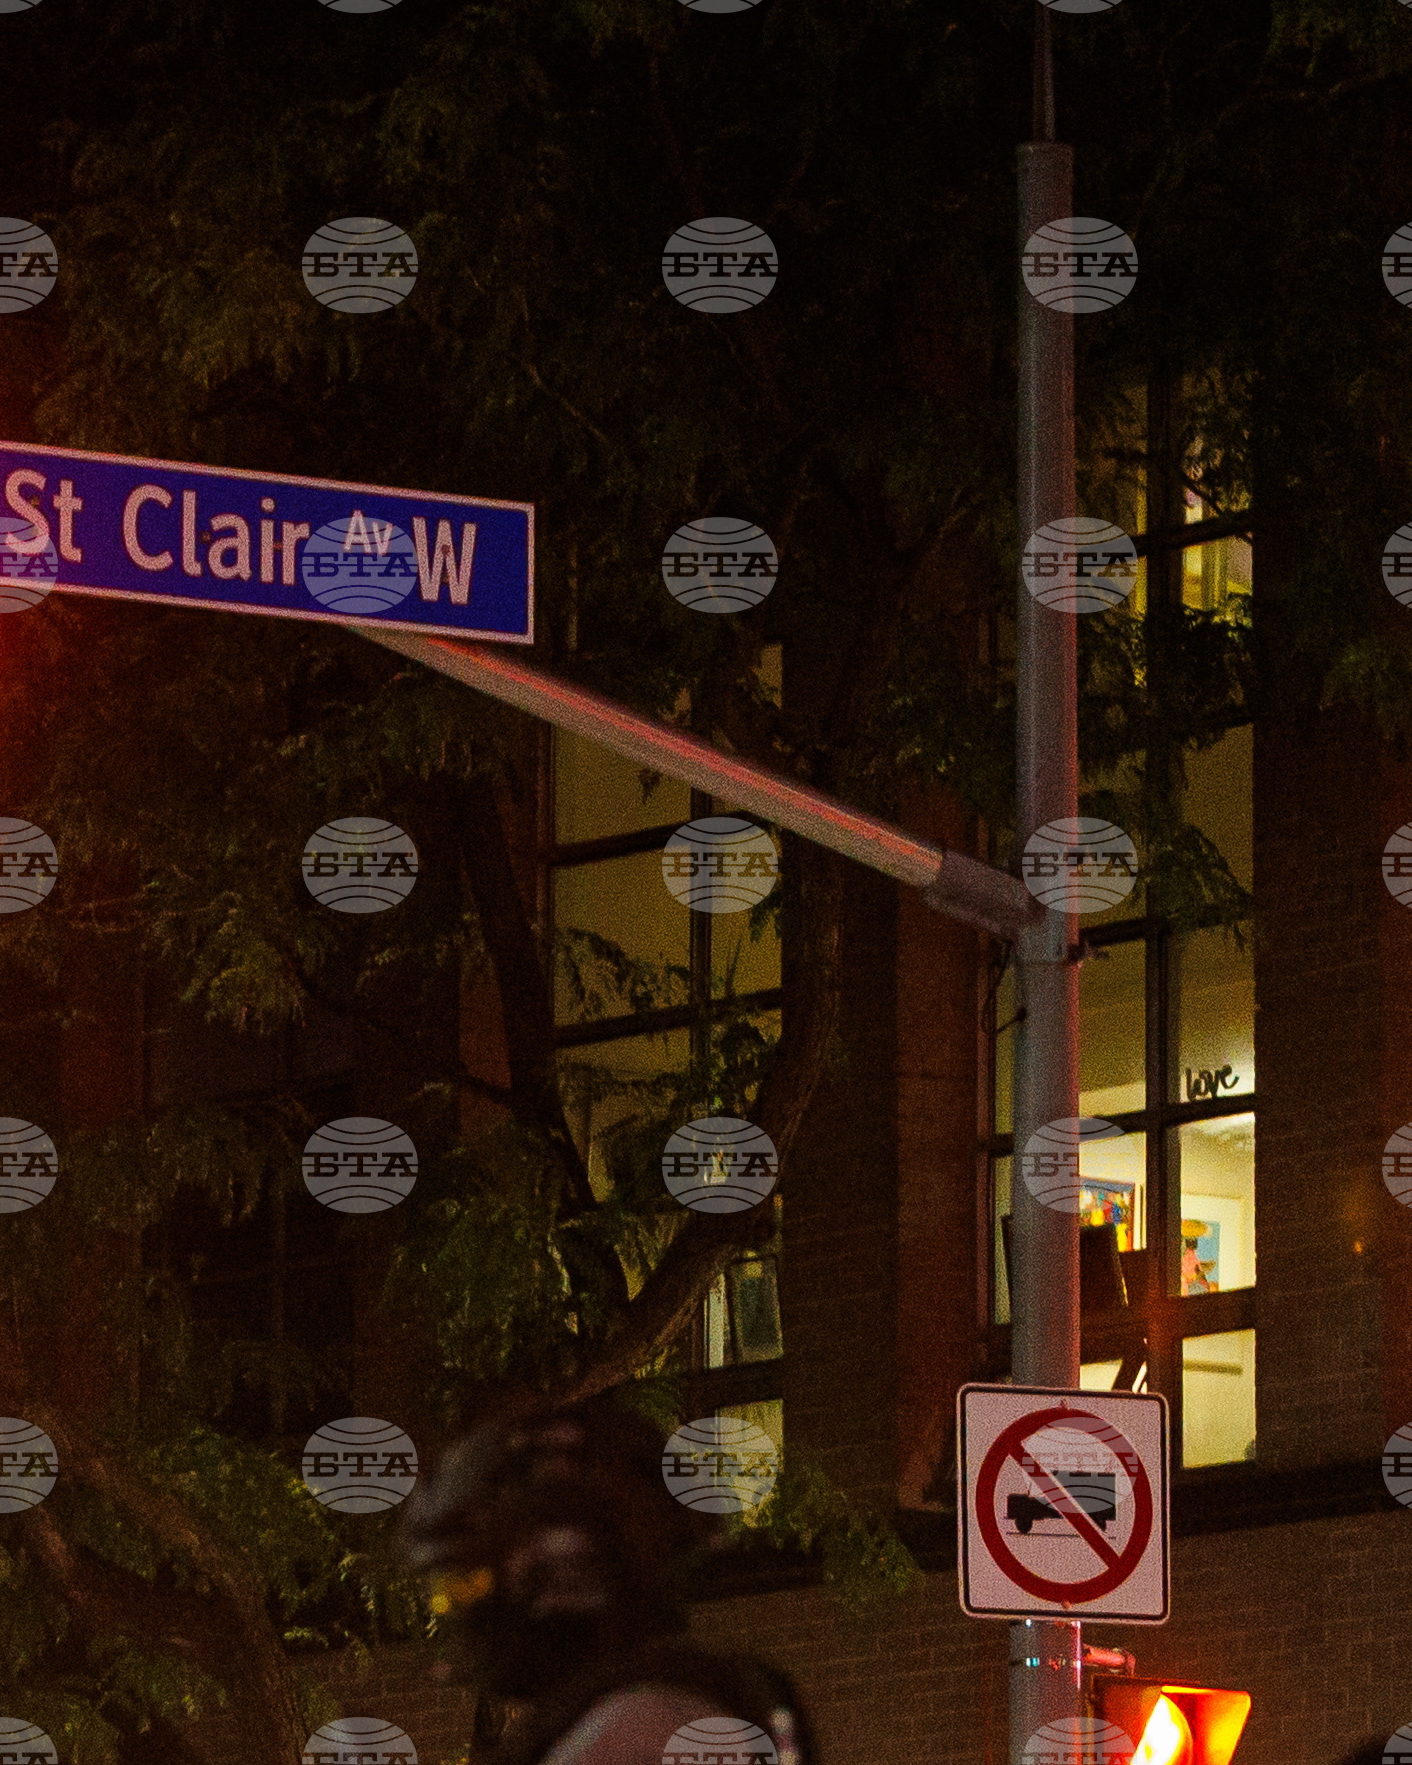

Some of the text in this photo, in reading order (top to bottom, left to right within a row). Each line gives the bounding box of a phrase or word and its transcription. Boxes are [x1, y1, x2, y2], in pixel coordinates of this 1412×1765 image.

[4, 468, 477, 606] St Clair Av W
